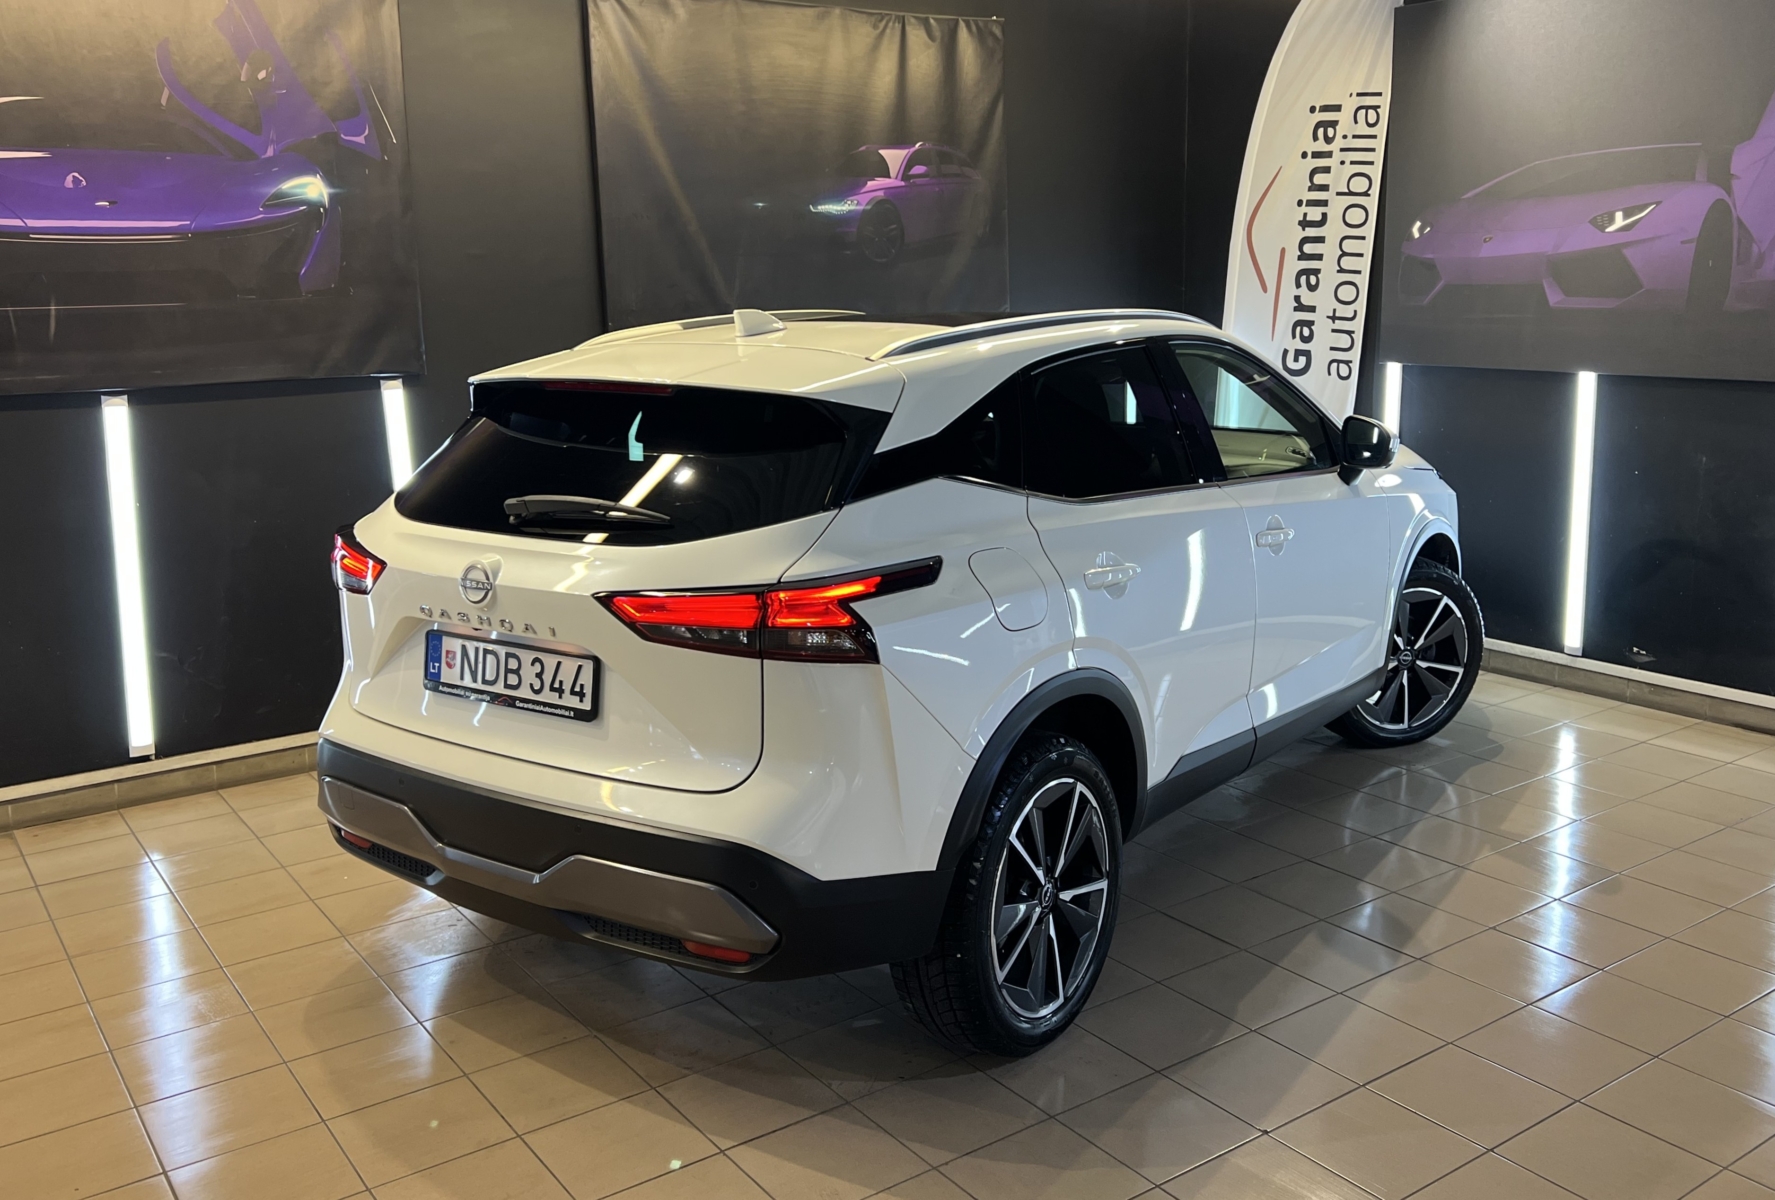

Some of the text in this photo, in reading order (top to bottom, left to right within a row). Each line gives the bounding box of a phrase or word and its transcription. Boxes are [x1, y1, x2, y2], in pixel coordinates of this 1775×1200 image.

[1281, 103, 1343, 378] Garantiniai
[1326, 91, 1384, 381] automobiliai
[460, 579, 492, 590] SSAN
[419, 604, 557, 638] QASHQAI
[430, 661, 440, 674] LT
